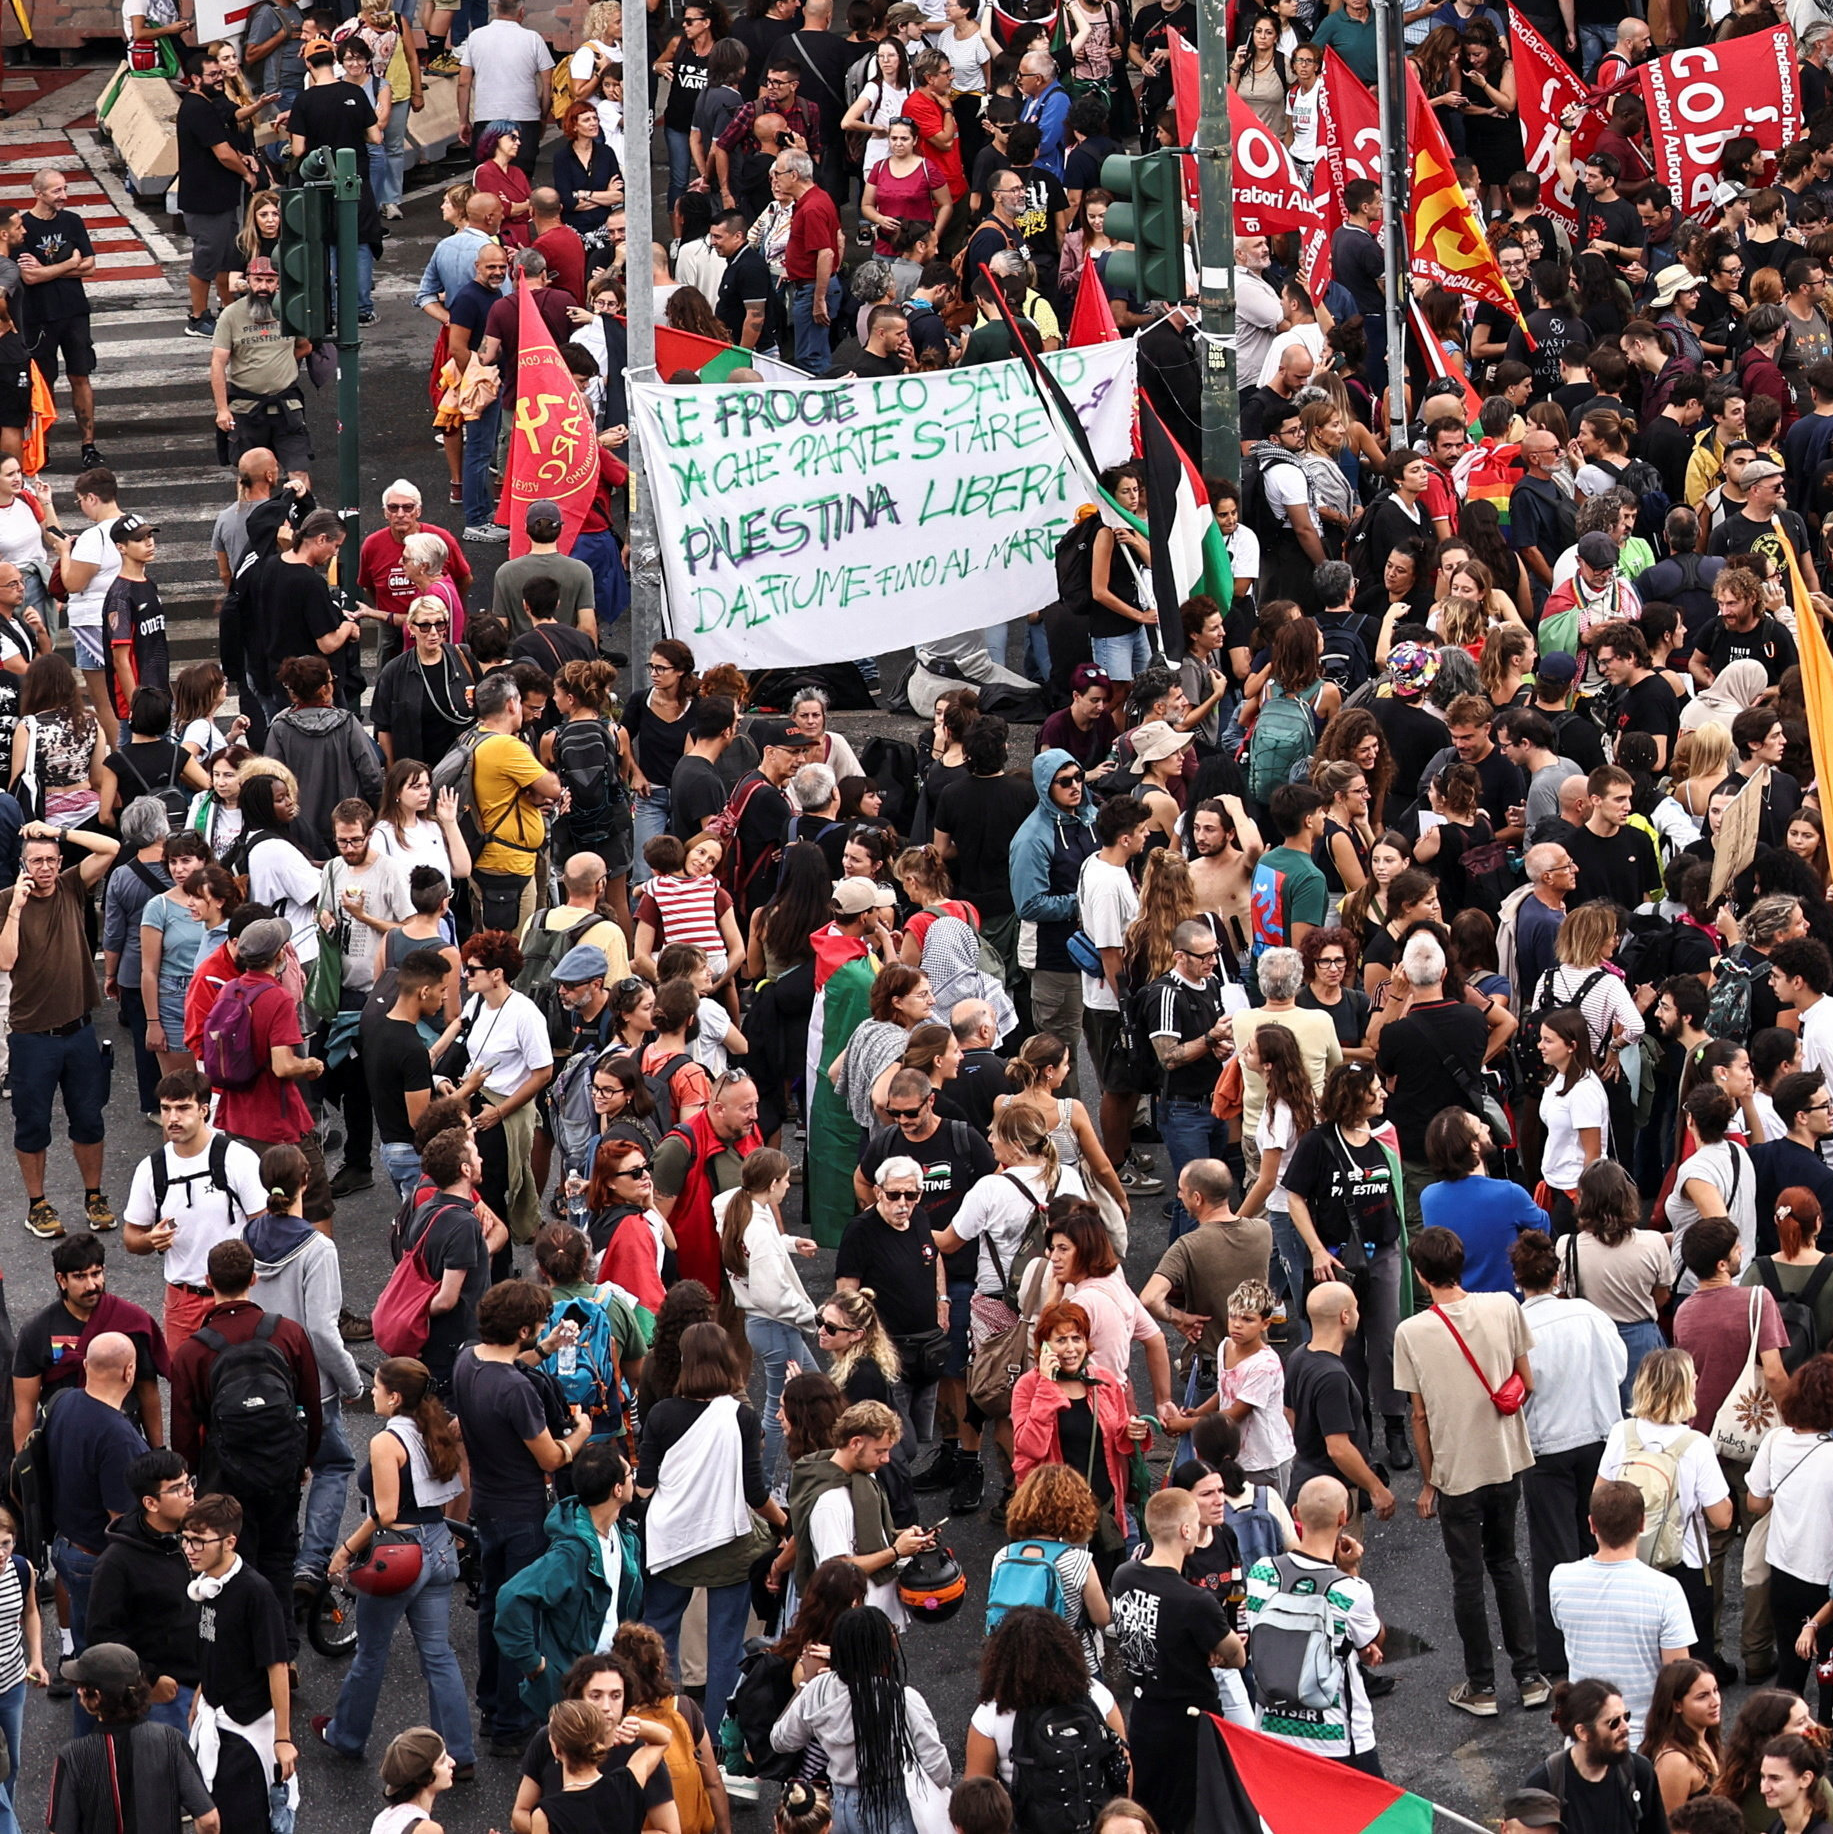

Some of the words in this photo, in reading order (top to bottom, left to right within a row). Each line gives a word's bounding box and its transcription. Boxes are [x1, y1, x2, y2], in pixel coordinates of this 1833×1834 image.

[1772, 31, 1794, 121] Sindacato
[1208, 351, 1225, 360] DDL
[657, 395, 704, 450] LE
[872, 376, 928, 415] LO
[713, 440, 783, 491] CHE
[788, 416, 901, 478] PARTE
[910, 405, 1057, 462] STARE
[683, 481, 902, 578] PALESTINA
[918, 455, 1070, 526] LIBERA
[692, 572, 769, 636] DAL
[757, 563, 873, 616] FIUME
[873, 554, 938, 598] FINO
[940, 546, 980, 585] AL
[1330, 1182, 1390, 1198] PAESTINE
[1332, 1170, 1365, 1183] FEE
[1716, 1428, 1748, 1455] babes
[1110, 1595, 1159, 1627] NORTH
[1132, 1587, 1161, 1609] THE
[1122, 1616, 1159, 1641] FACE
